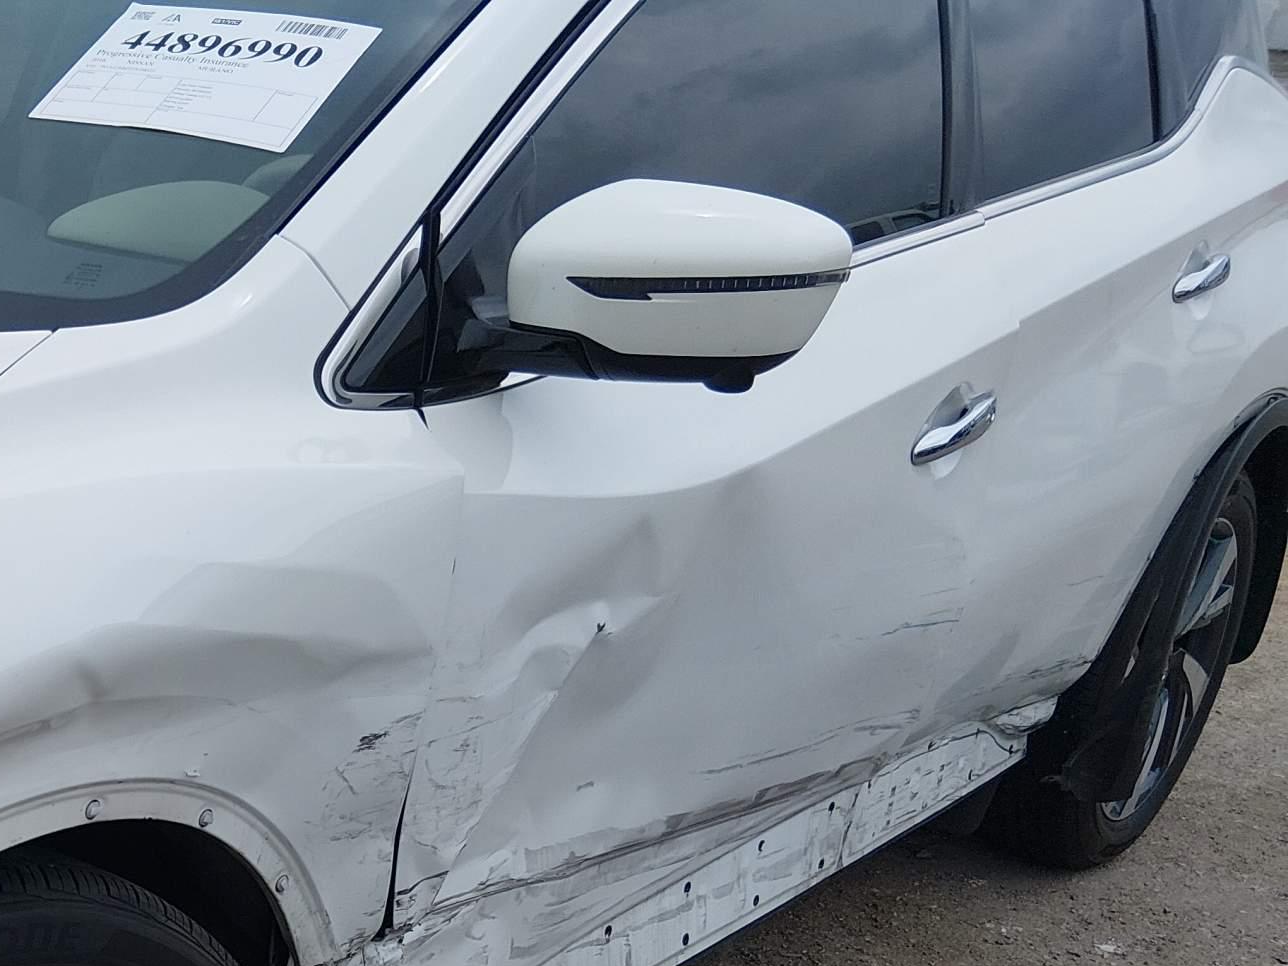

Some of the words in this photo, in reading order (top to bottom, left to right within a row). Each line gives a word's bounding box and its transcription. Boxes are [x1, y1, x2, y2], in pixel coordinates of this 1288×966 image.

[96, 49, 153, 60] Progressive
[154, 52, 197, 64] Casualty
[199, 56, 249, 69] Insurance
[121, 29, 324, 69] 44896990
